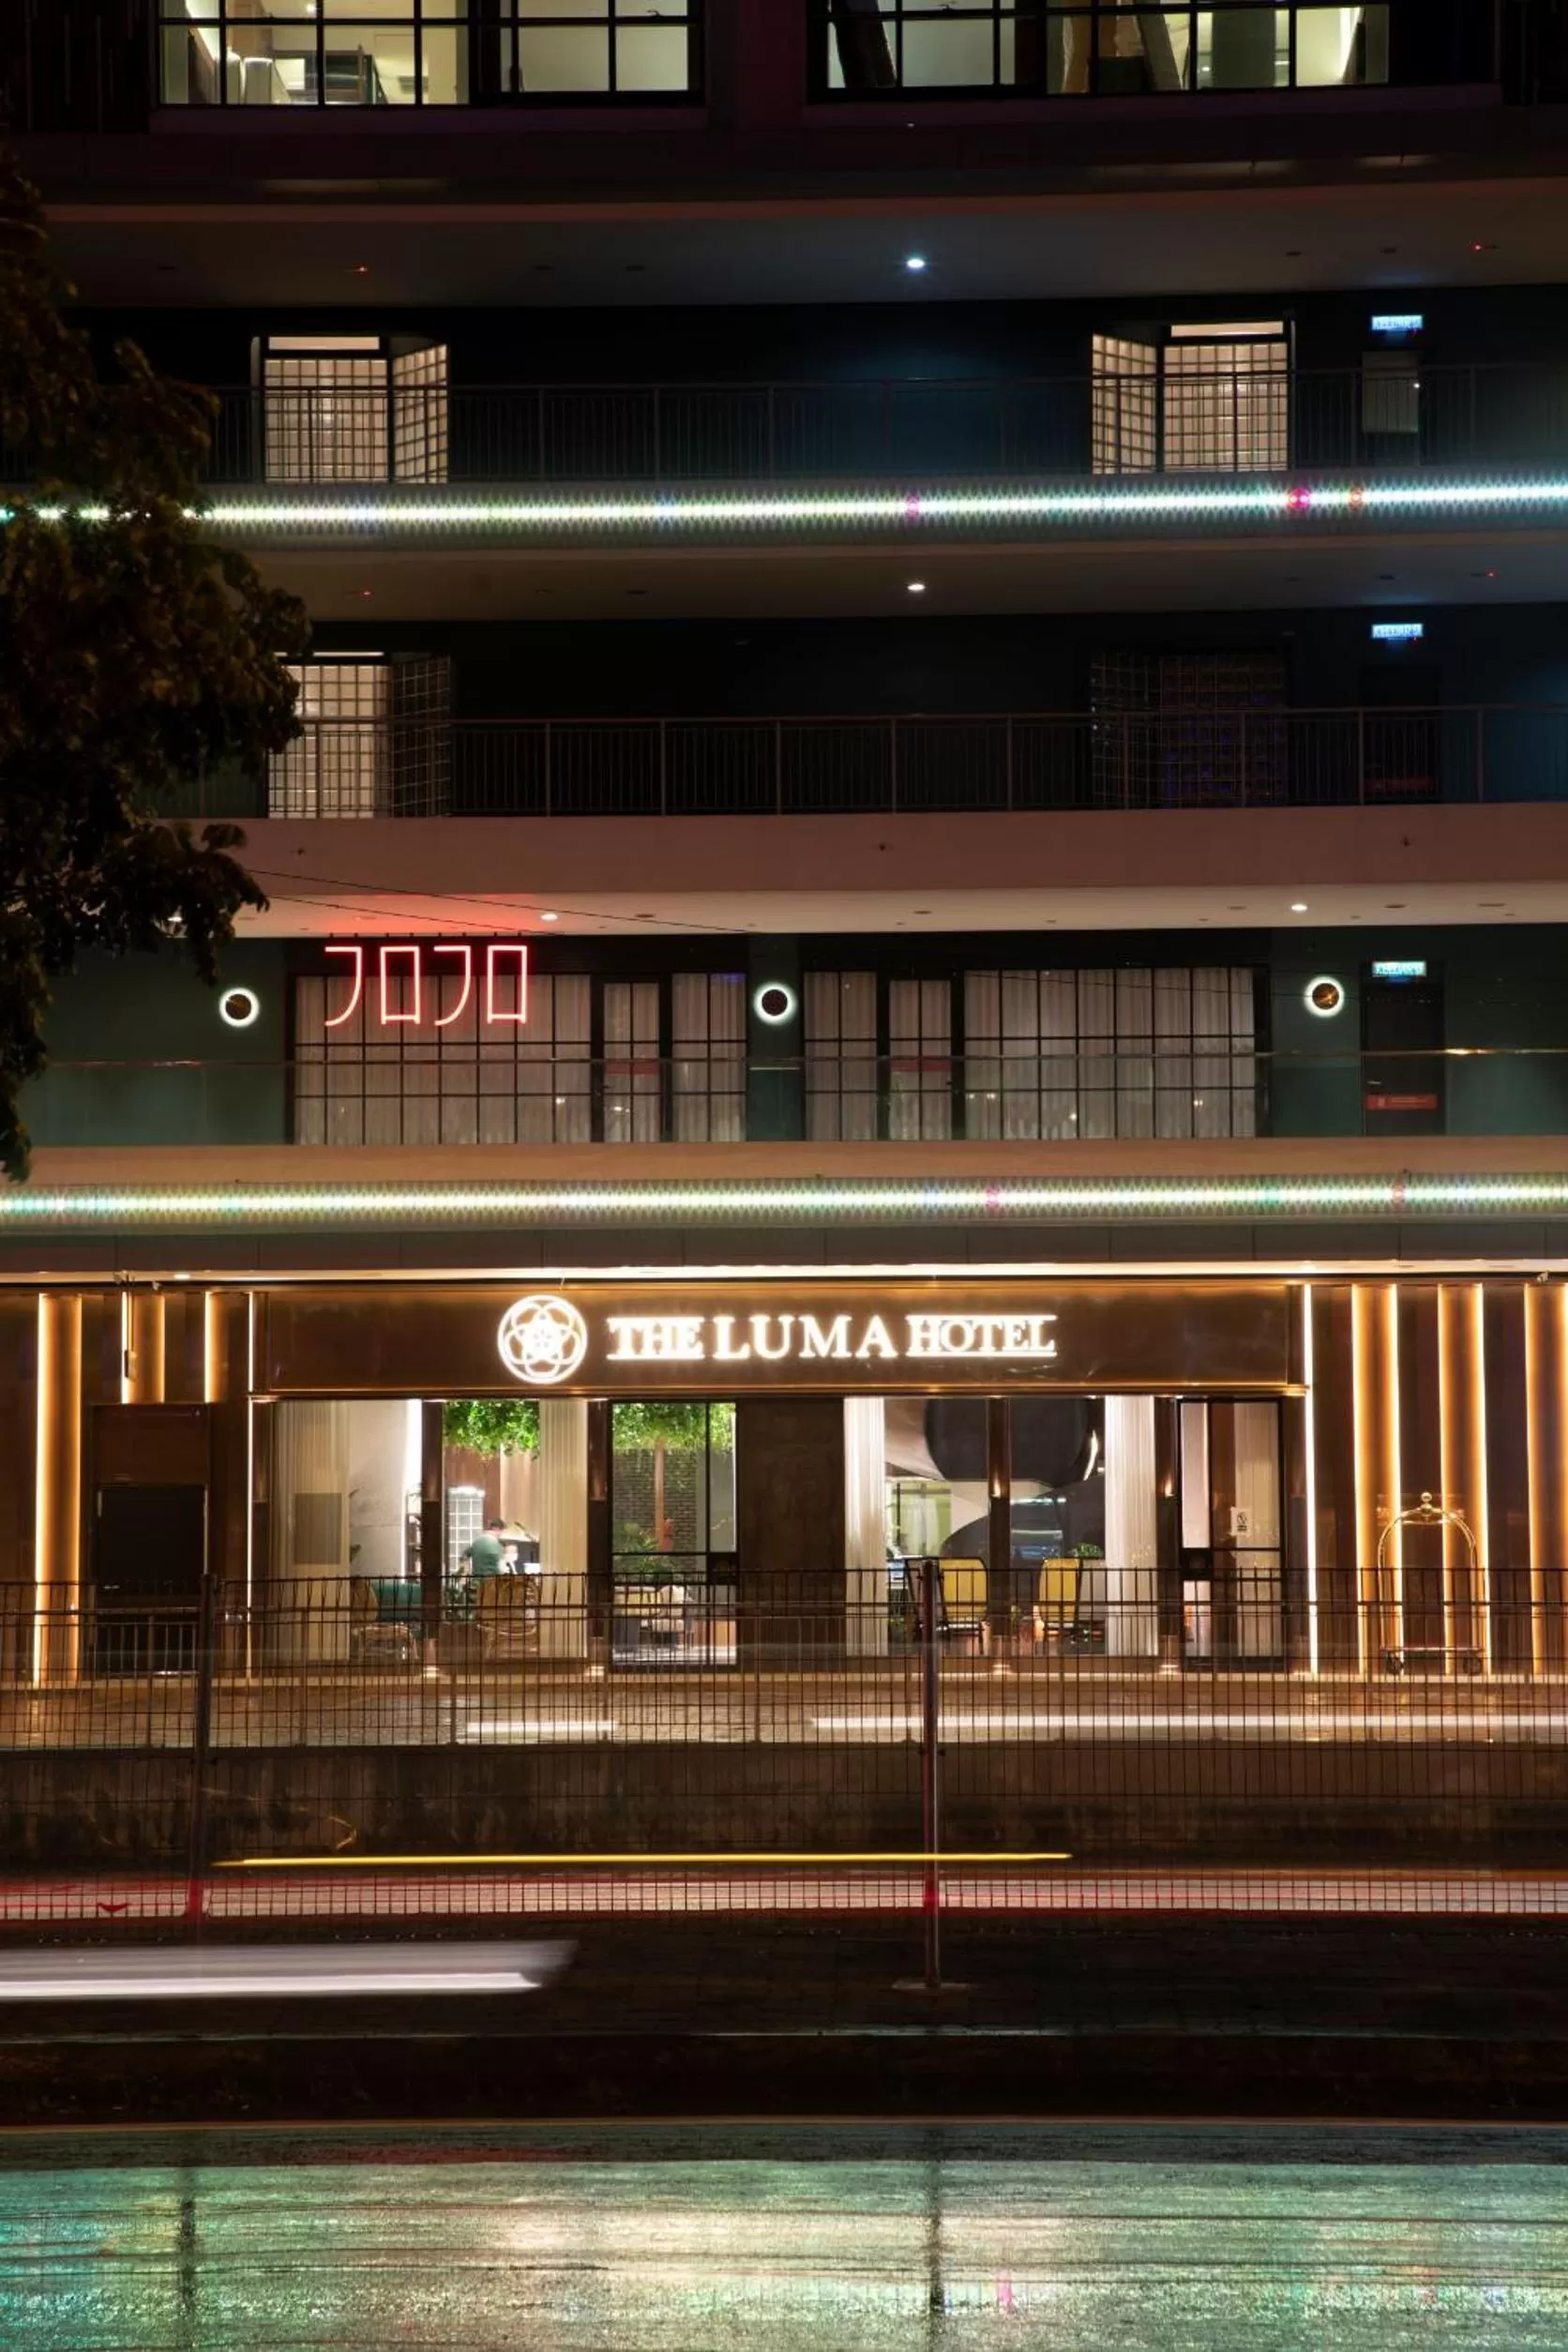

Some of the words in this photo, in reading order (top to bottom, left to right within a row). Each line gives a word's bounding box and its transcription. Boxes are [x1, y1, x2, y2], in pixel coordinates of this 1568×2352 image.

[606, 1316, 705, 1360] THE
[713, 1315, 898, 1360] LUMA
[905, 1315, 1058, 1357] HOTEL
